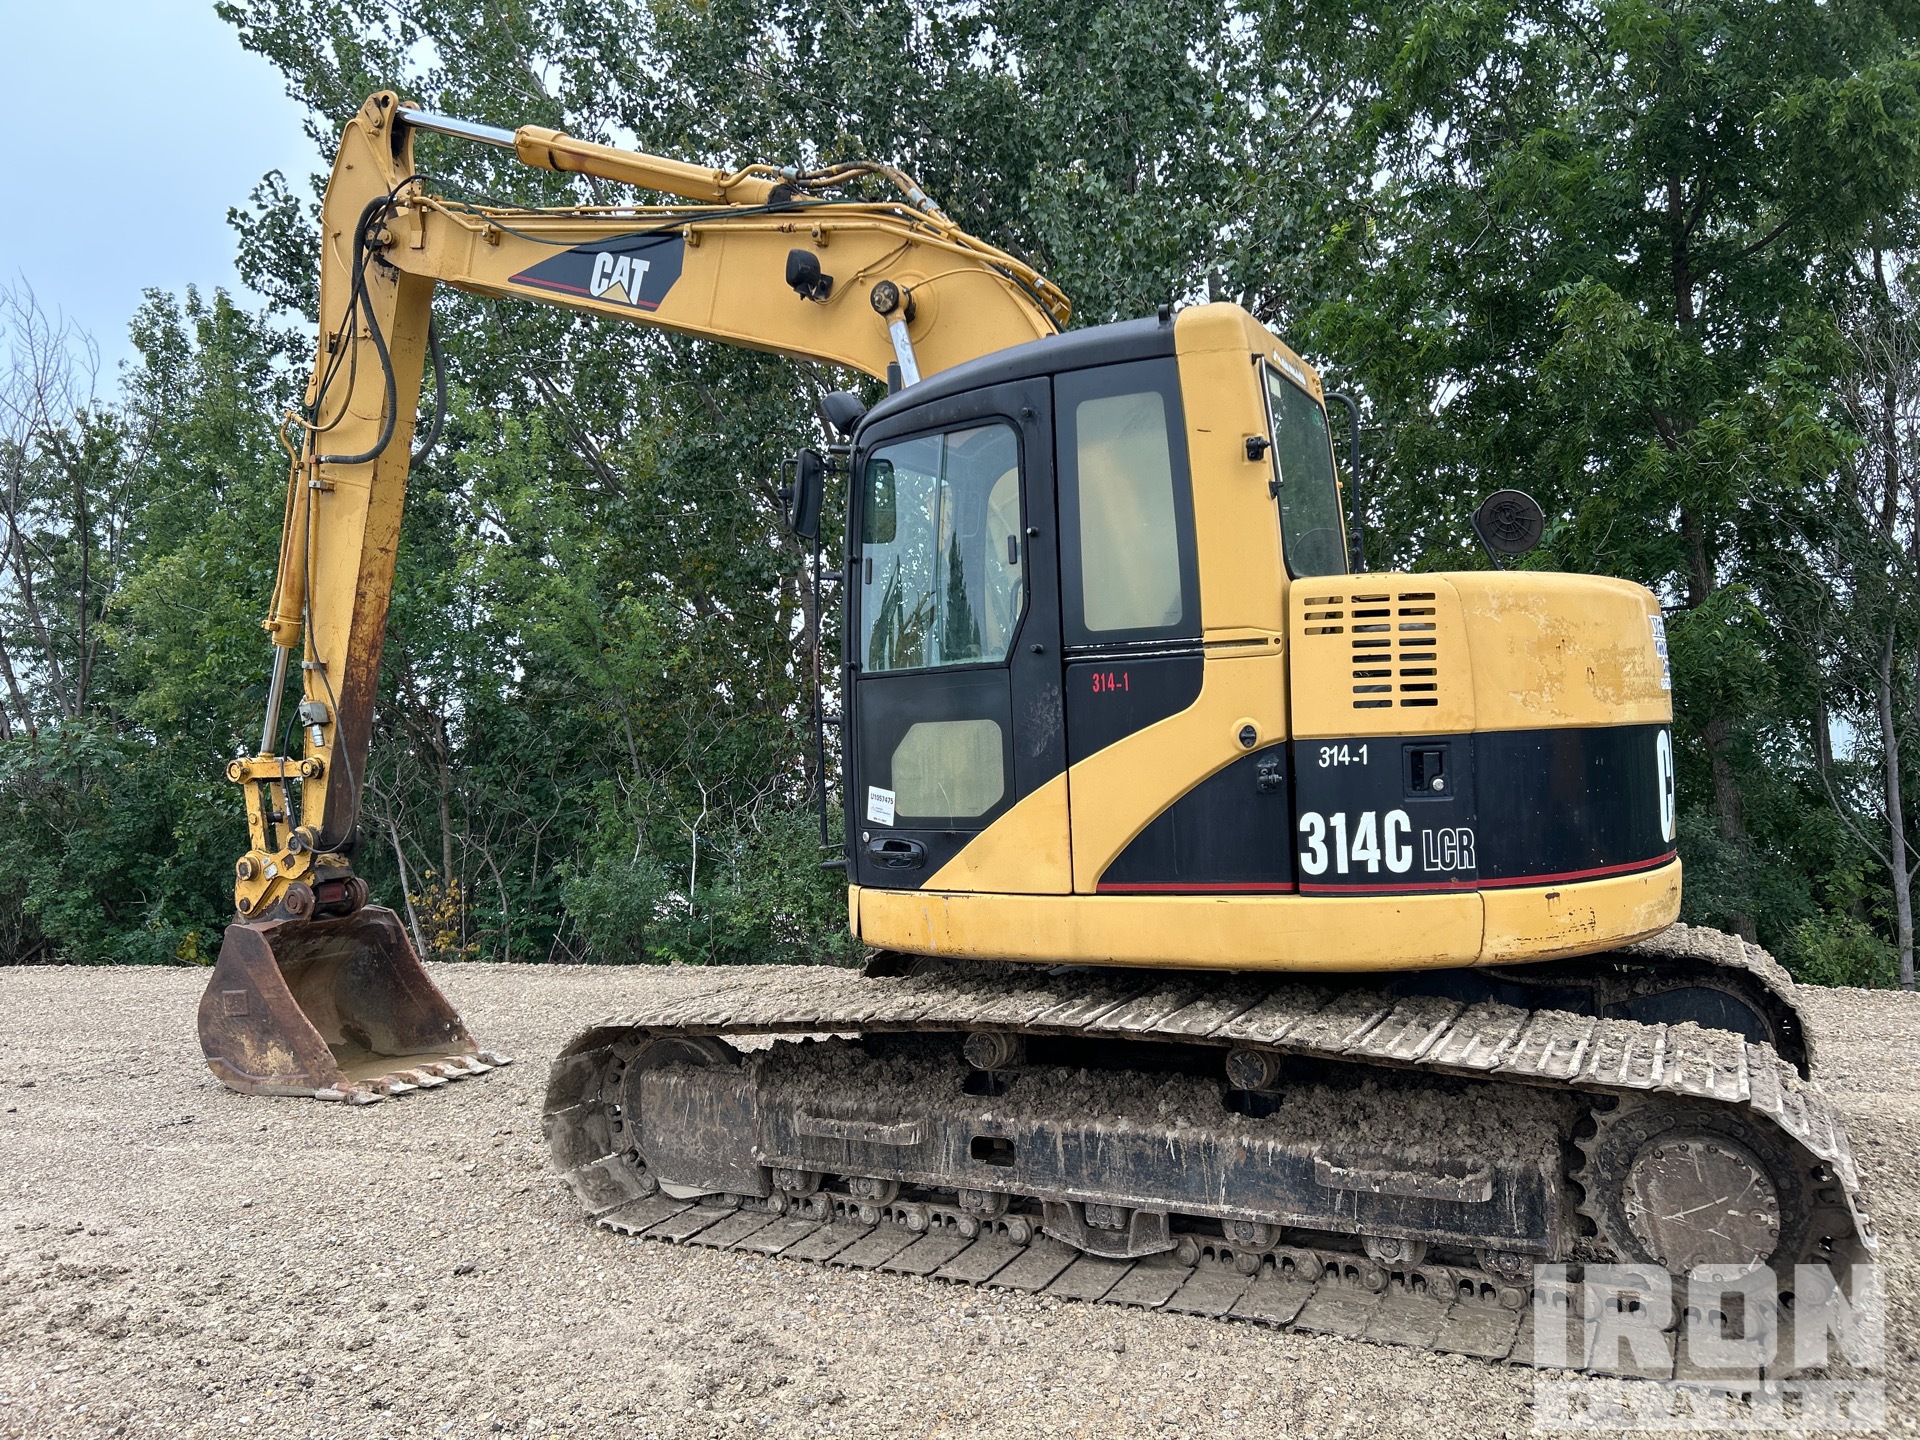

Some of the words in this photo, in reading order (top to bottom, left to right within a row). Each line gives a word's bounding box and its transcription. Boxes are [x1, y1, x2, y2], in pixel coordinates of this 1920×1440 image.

[589, 252, 650, 305] CAT
[1092, 671, 1129, 693] 314-1
[1318, 744, 1368, 768] 314-1
[1299, 809, 1413, 875] 314C
[1422, 828, 1476, 871] LCR
